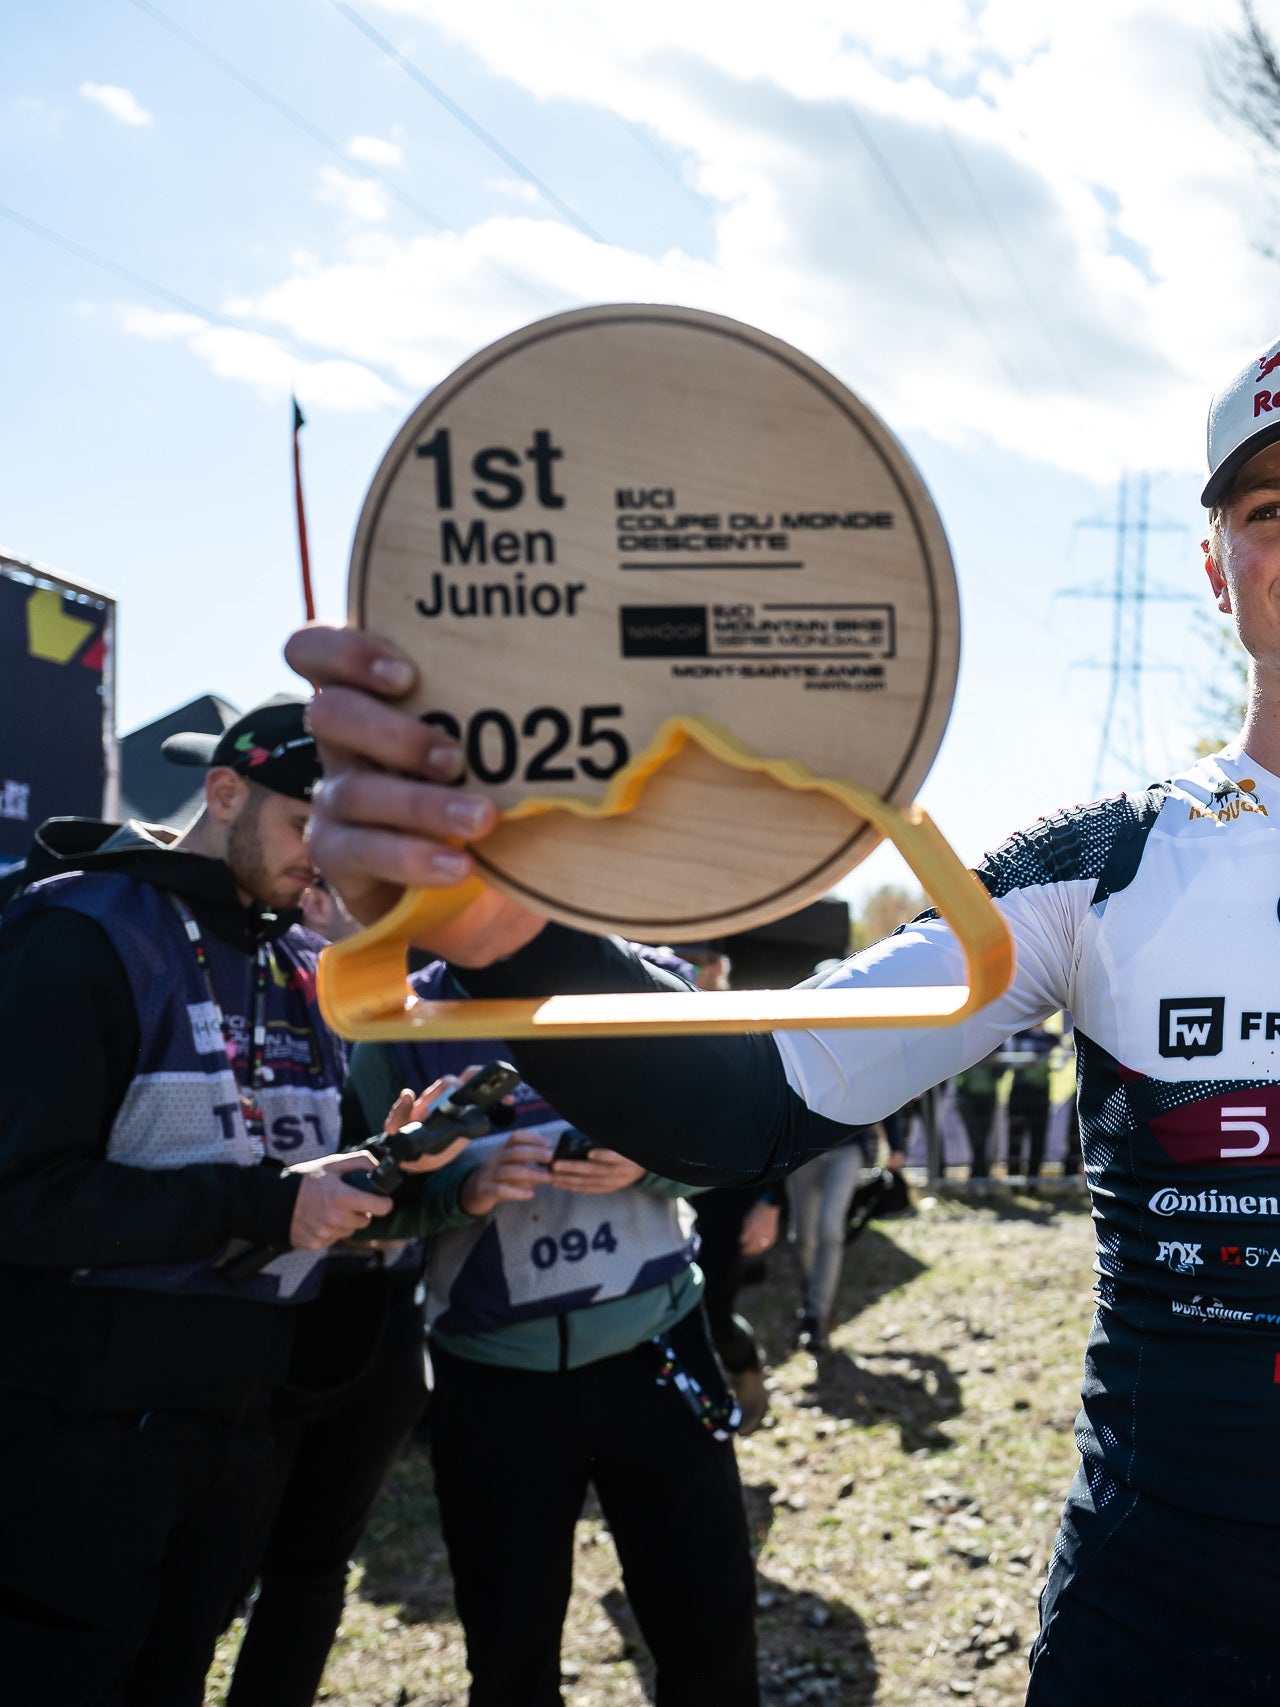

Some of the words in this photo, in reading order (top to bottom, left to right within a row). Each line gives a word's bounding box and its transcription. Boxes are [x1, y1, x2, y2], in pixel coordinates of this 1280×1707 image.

[415, 428, 566, 511] 1st
[440, 519, 555, 566] Men
[616, 513, 721, 531] COUPE
[729, 513, 773, 530] DU
[781, 512, 894, 530] MONDE
[616, 532, 789, 551] DESCENTE
[415, 571, 586, 619] Junior
[531, 1222, 619, 1273] 094
[1155, 1241, 1204, 1271] FOX
